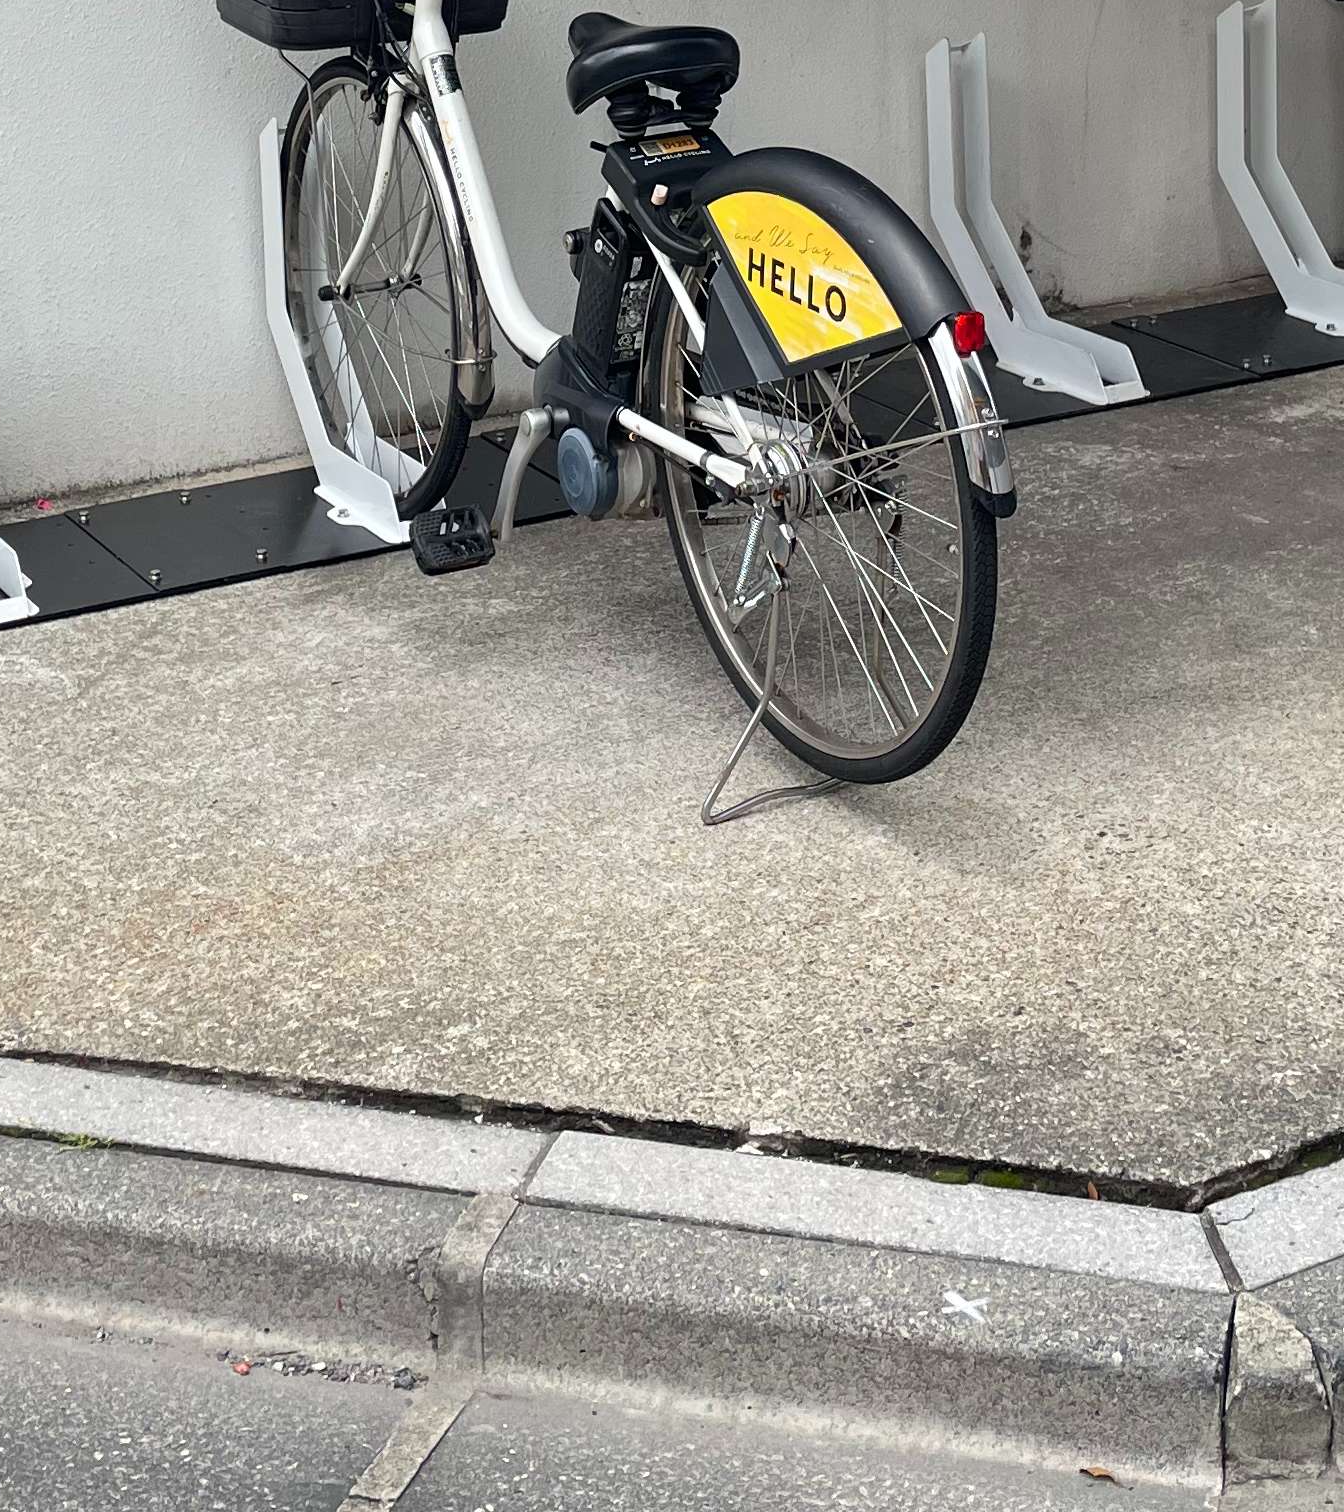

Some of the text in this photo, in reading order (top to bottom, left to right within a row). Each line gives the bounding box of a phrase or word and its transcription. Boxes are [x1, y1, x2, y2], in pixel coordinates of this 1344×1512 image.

[450, 147, 474, 223] HELLO CYCLING
[735, 225, 834, 264] and We Say
[747, 247, 847, 323] HELLO
